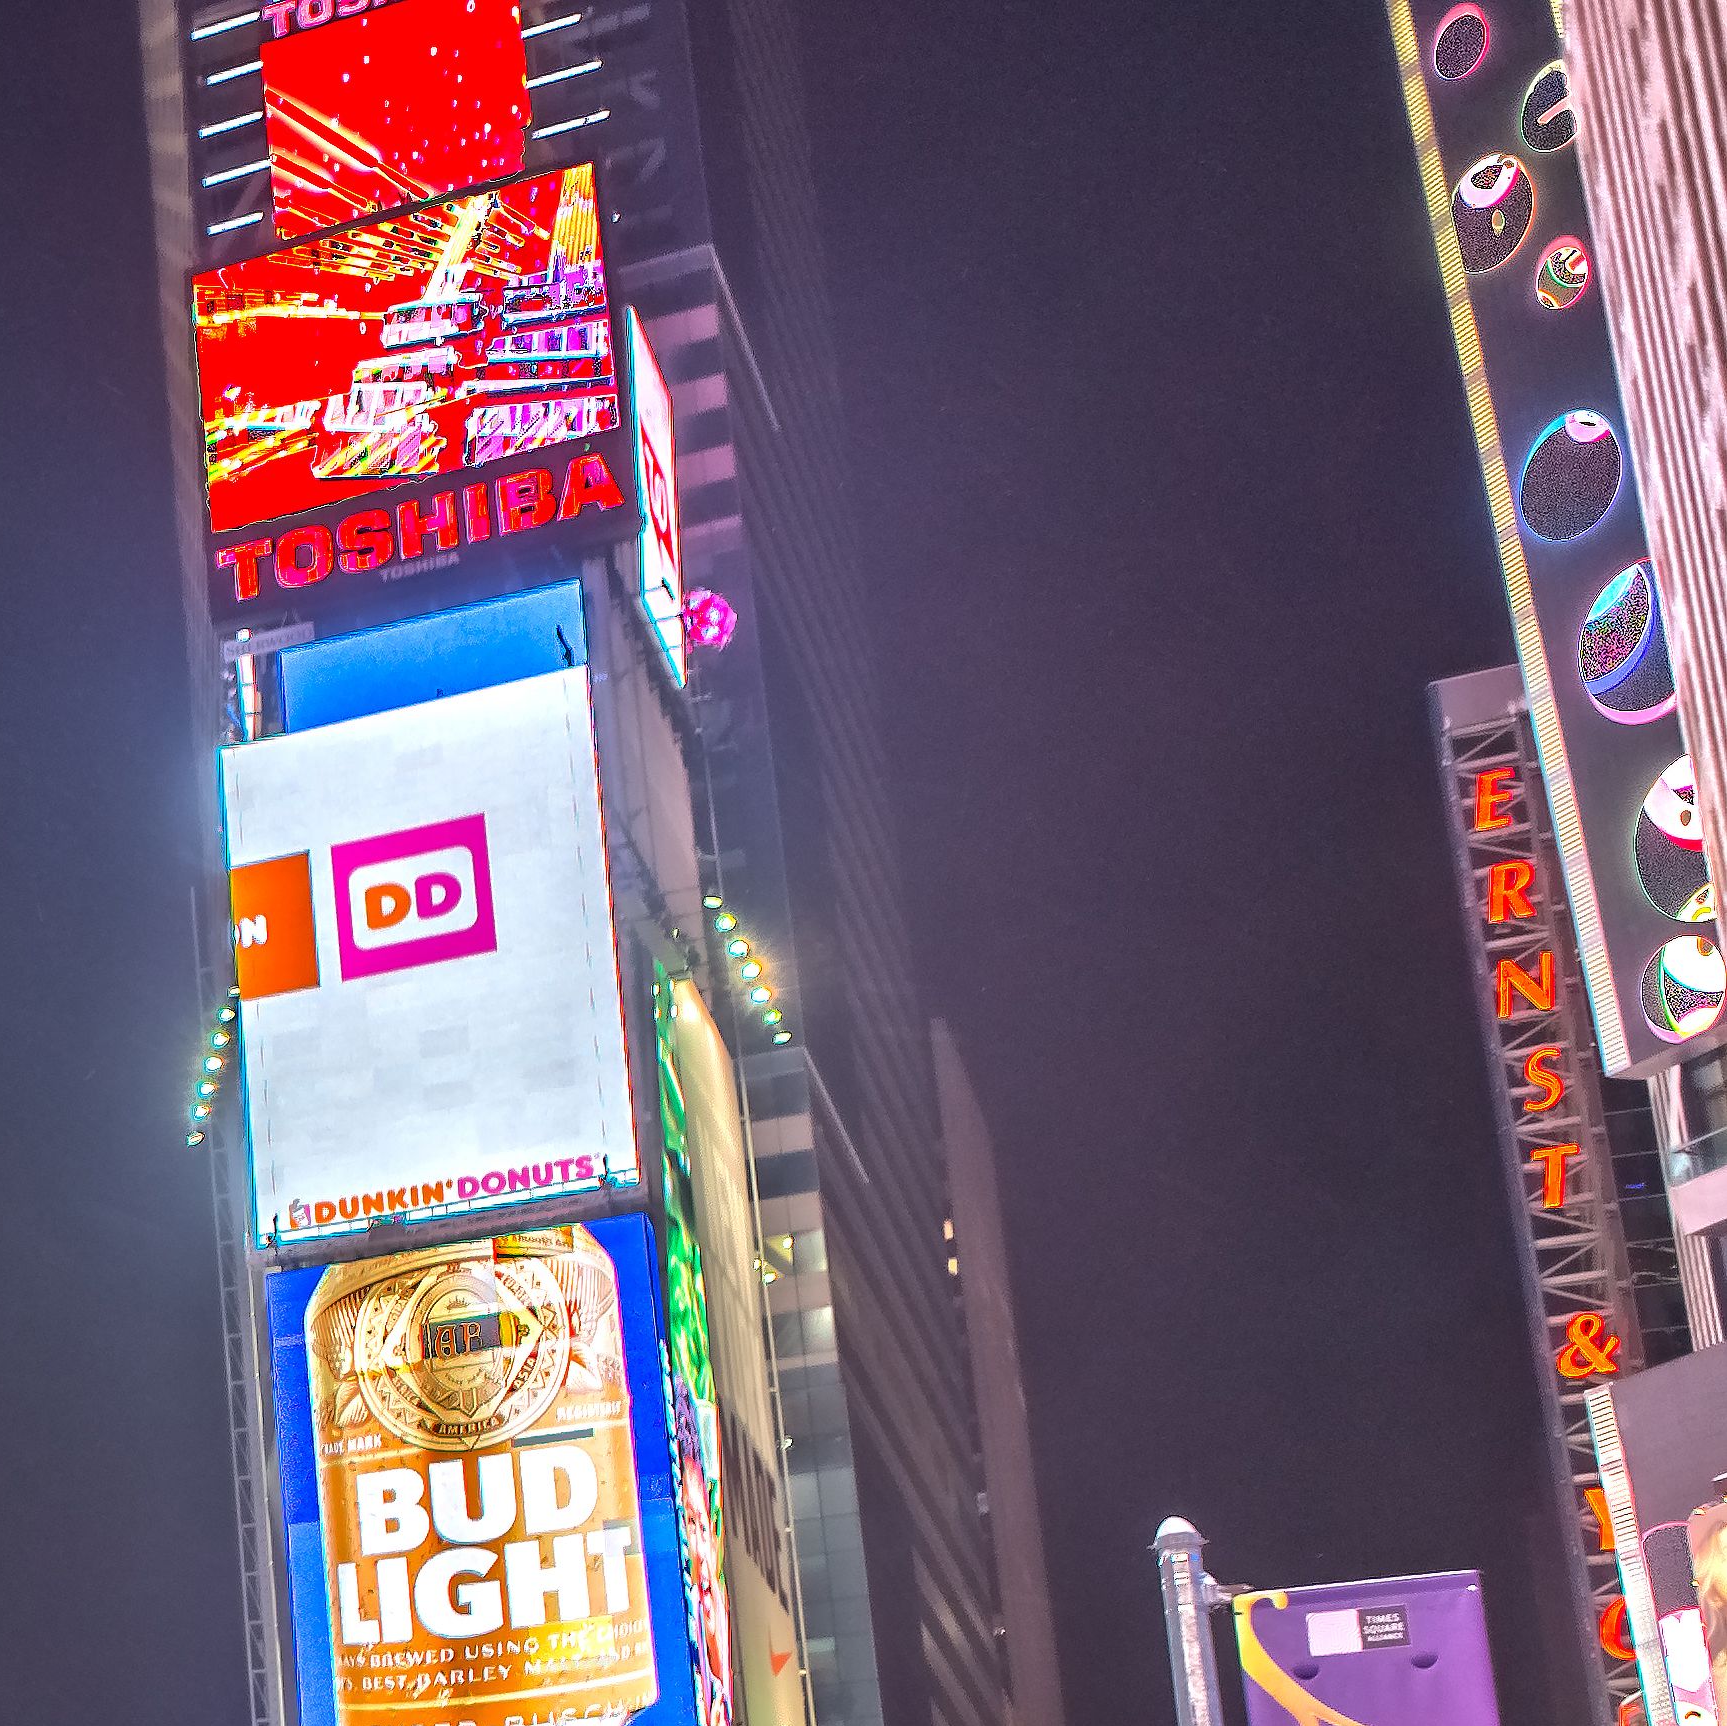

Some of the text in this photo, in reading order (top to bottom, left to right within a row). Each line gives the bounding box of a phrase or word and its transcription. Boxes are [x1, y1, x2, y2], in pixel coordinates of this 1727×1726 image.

[215, 451, 627, 603] TOSHIBA
[363, 870, 463, 932] DD
[1473, 766, 1582, 1210] ERNST
[313, 1155, 597, 1226] DUNKIN' DONUTS
[1555, 1311, 1623, 1380] &
[353, 1445, 600, 1559] BUD
[337, 1526, 633, 1647] LIGHT
[1365, 1611, 1401, 1625] TIMES
[463, 1639, 540, 1661] USING
[1362, 1621, 1406, 1636] SQUARE
